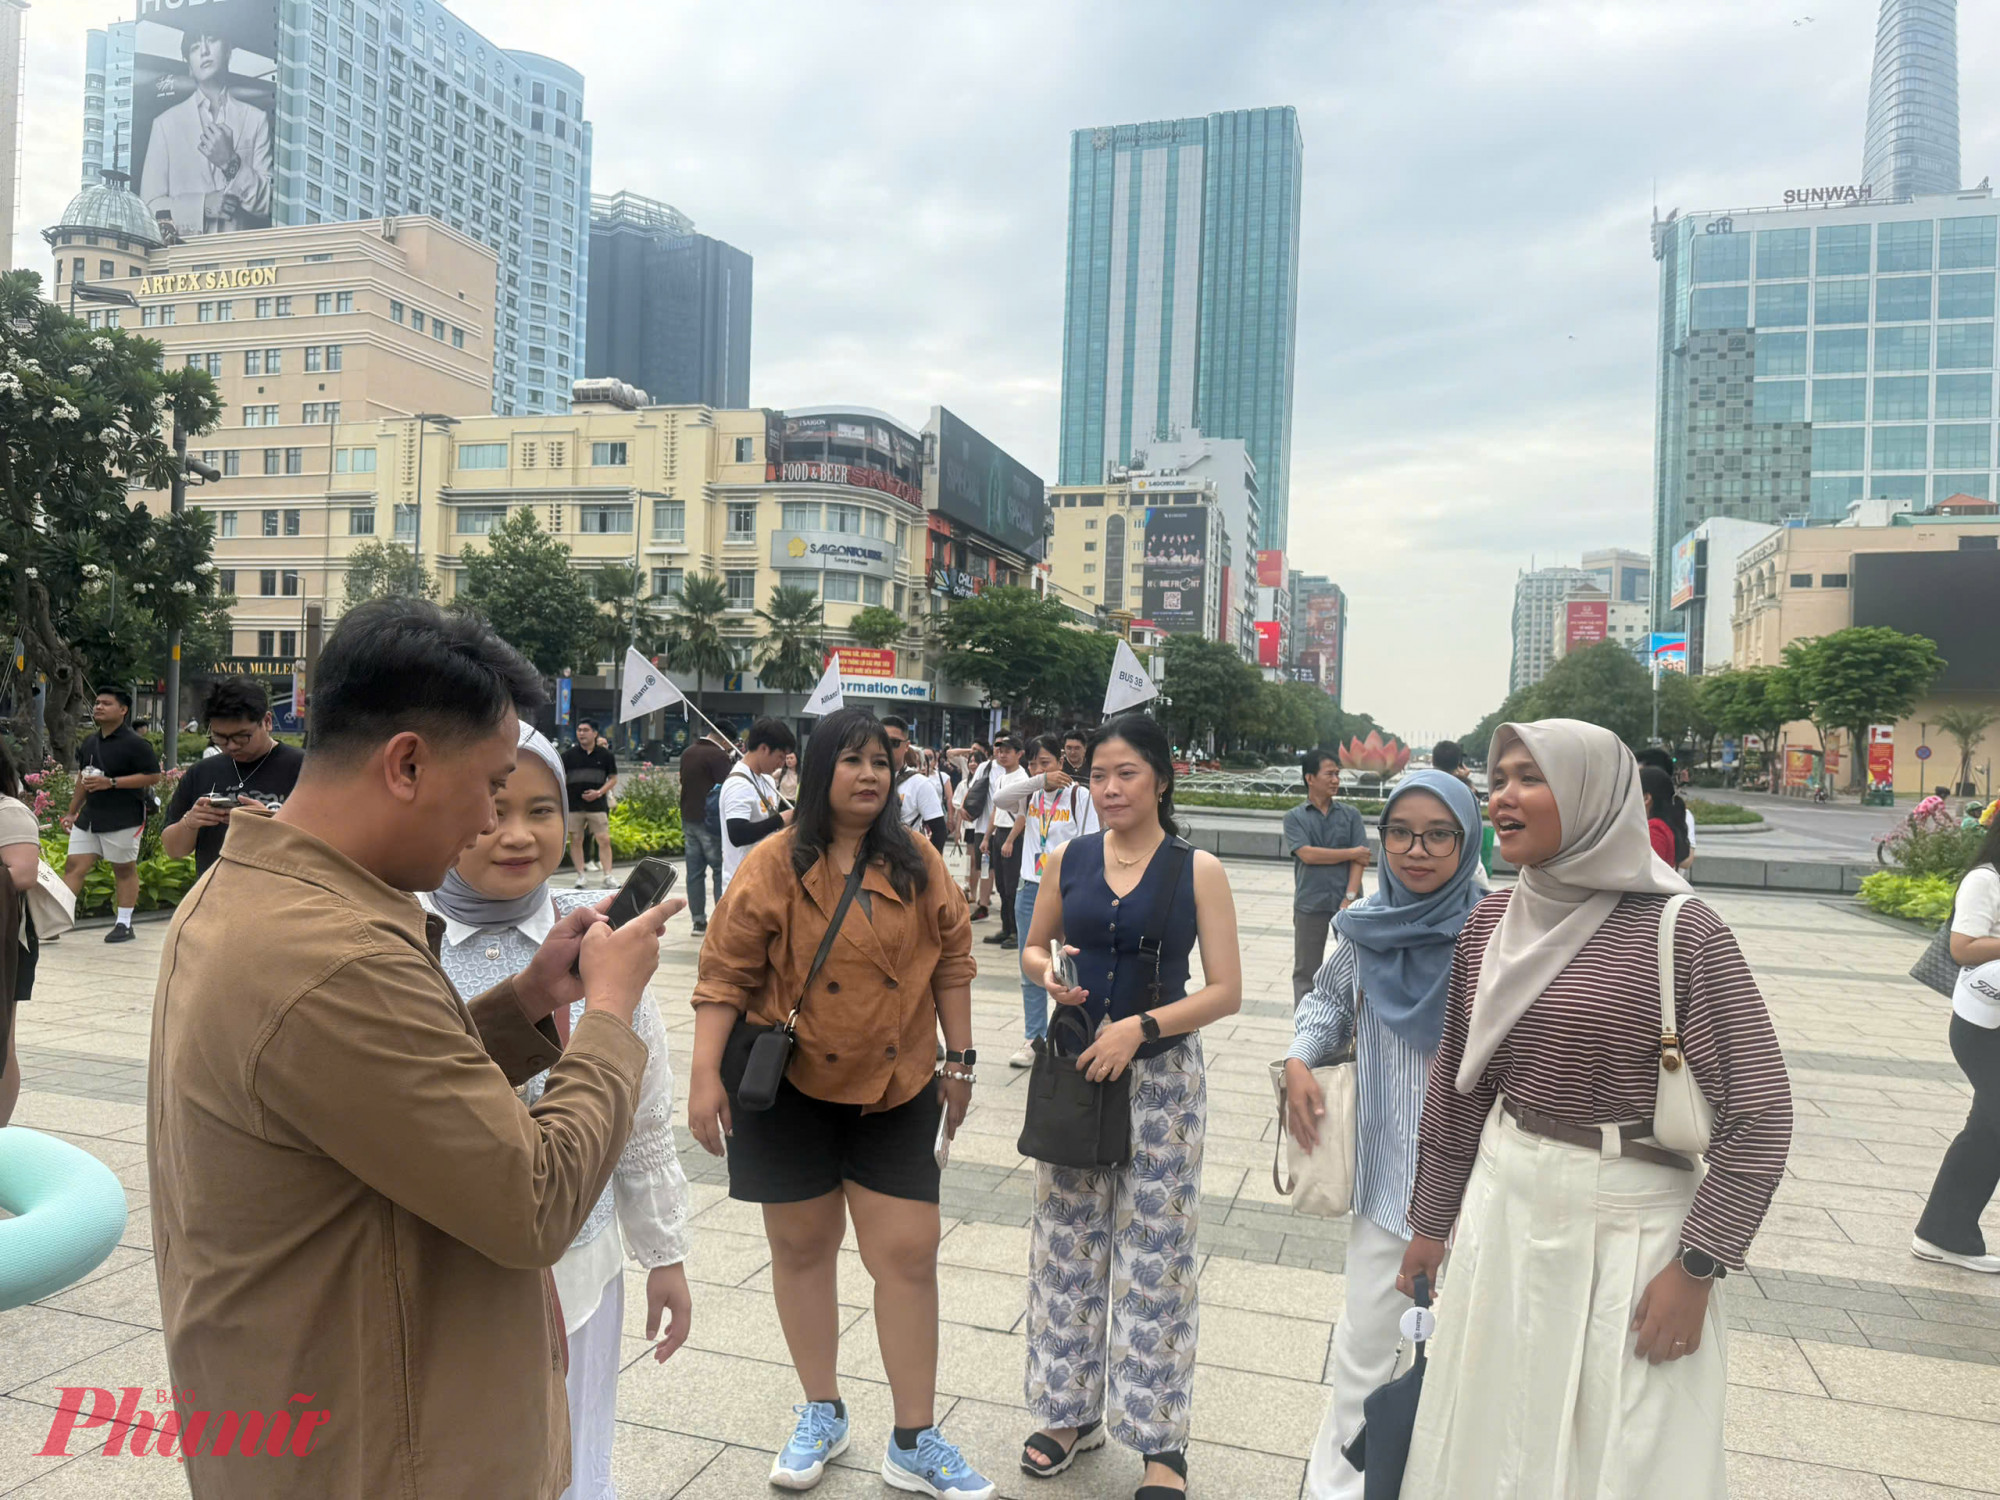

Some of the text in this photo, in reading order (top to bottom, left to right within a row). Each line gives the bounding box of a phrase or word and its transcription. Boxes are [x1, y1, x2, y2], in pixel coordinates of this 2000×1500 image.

[1783, 183, 1872, 204] SUNWAH
[139, 267, 277, 294] ARTEX SAIGON
[782, 463, 809, 481] FOOD
[810, 466, 818, 479] &
[820, 463, 848, 483] BEER
[206, 661, 245, 674] ANCK
[841, 680, 926, 697] ormation Center
[1119, 670, 1144, 687] BUS 3B
[631, 684, 649, 706] Allianz
